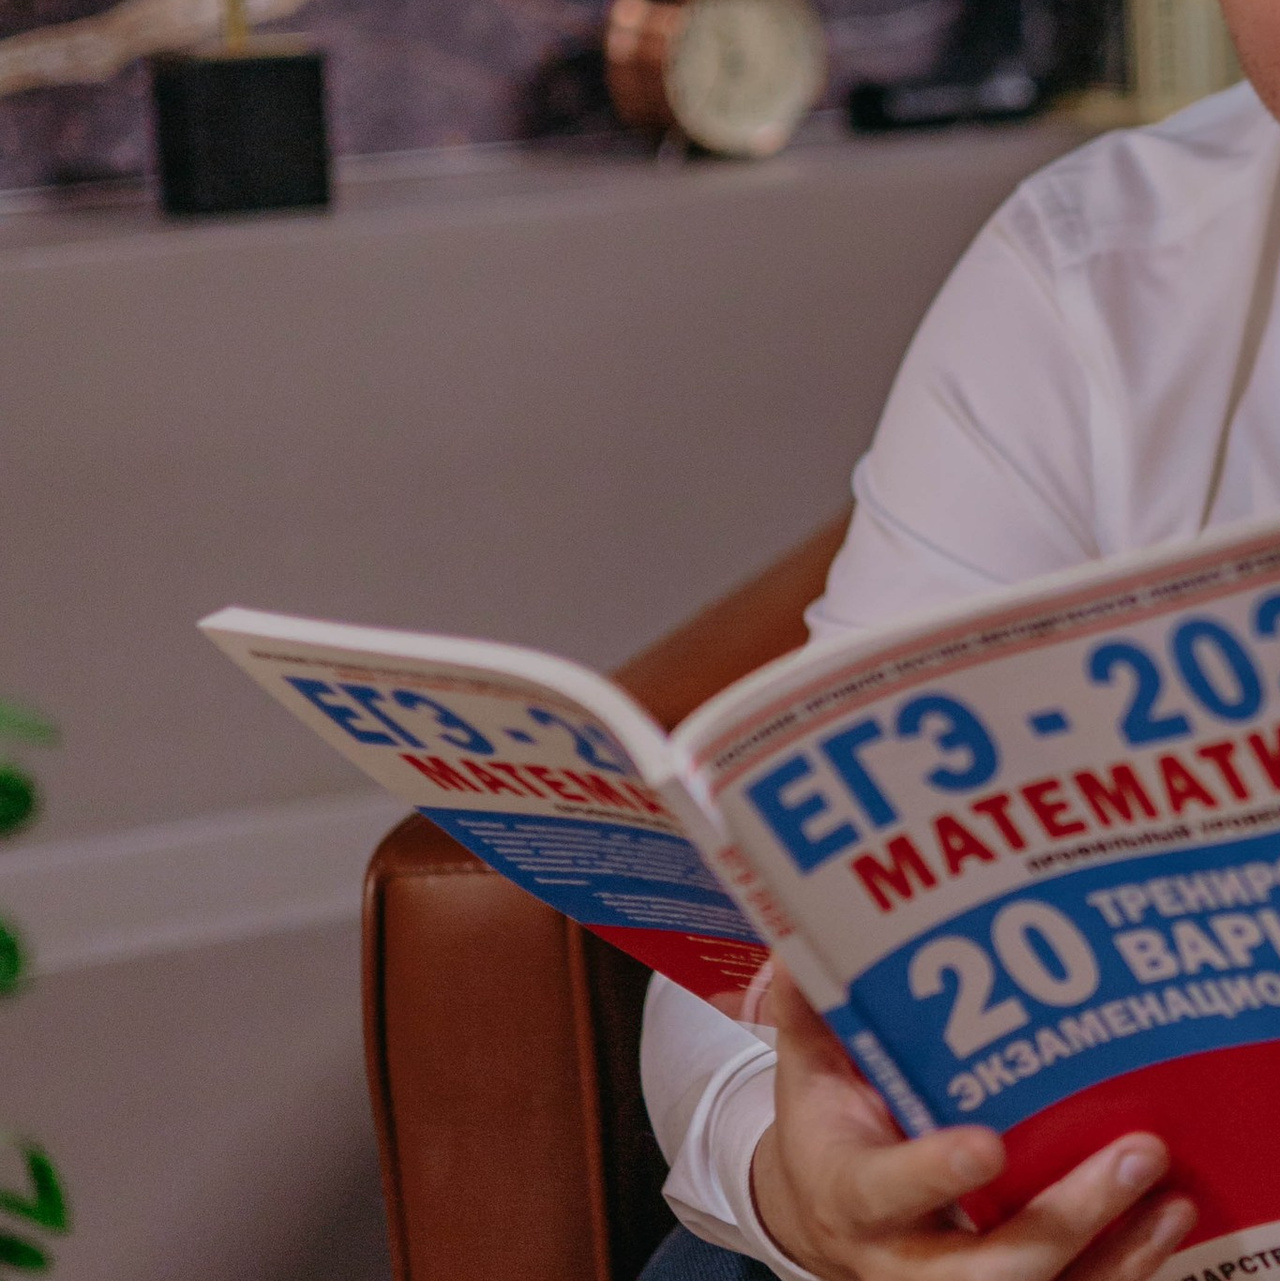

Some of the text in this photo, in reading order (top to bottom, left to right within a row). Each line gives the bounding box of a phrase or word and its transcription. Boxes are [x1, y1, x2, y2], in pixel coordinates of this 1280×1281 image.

[282, 675, 497, 756] ЕГЭ
[746, 692, 1000, 874] ЕГЭ
[908, 899, 1099, 1059] 20
